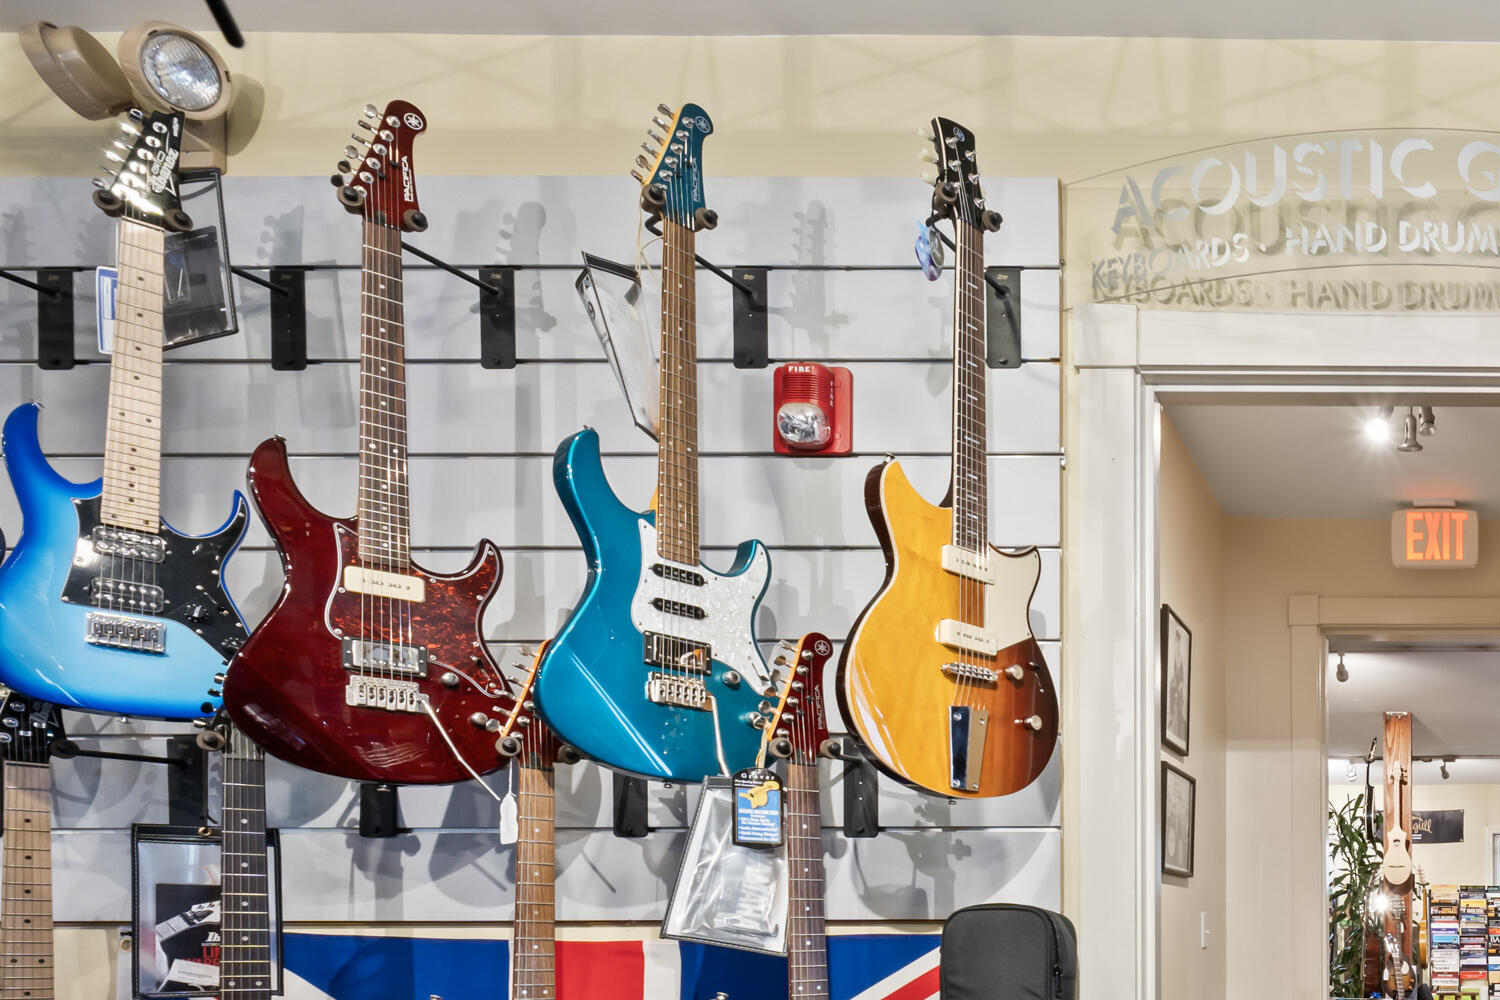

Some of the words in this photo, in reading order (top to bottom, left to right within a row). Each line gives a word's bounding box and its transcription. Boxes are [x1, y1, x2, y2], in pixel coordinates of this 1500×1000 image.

[402, 155, 411, 202] PACIFICA
[1111, 138, 1437, 235] ACOUSTIC
[1091, 233, 1250, 290] KEYBOARDS
[1285, 220, 1387, 256] HAND
[788, 365, 811, 373] FIRE
[1406, 511, 1469, 561] EXIT
